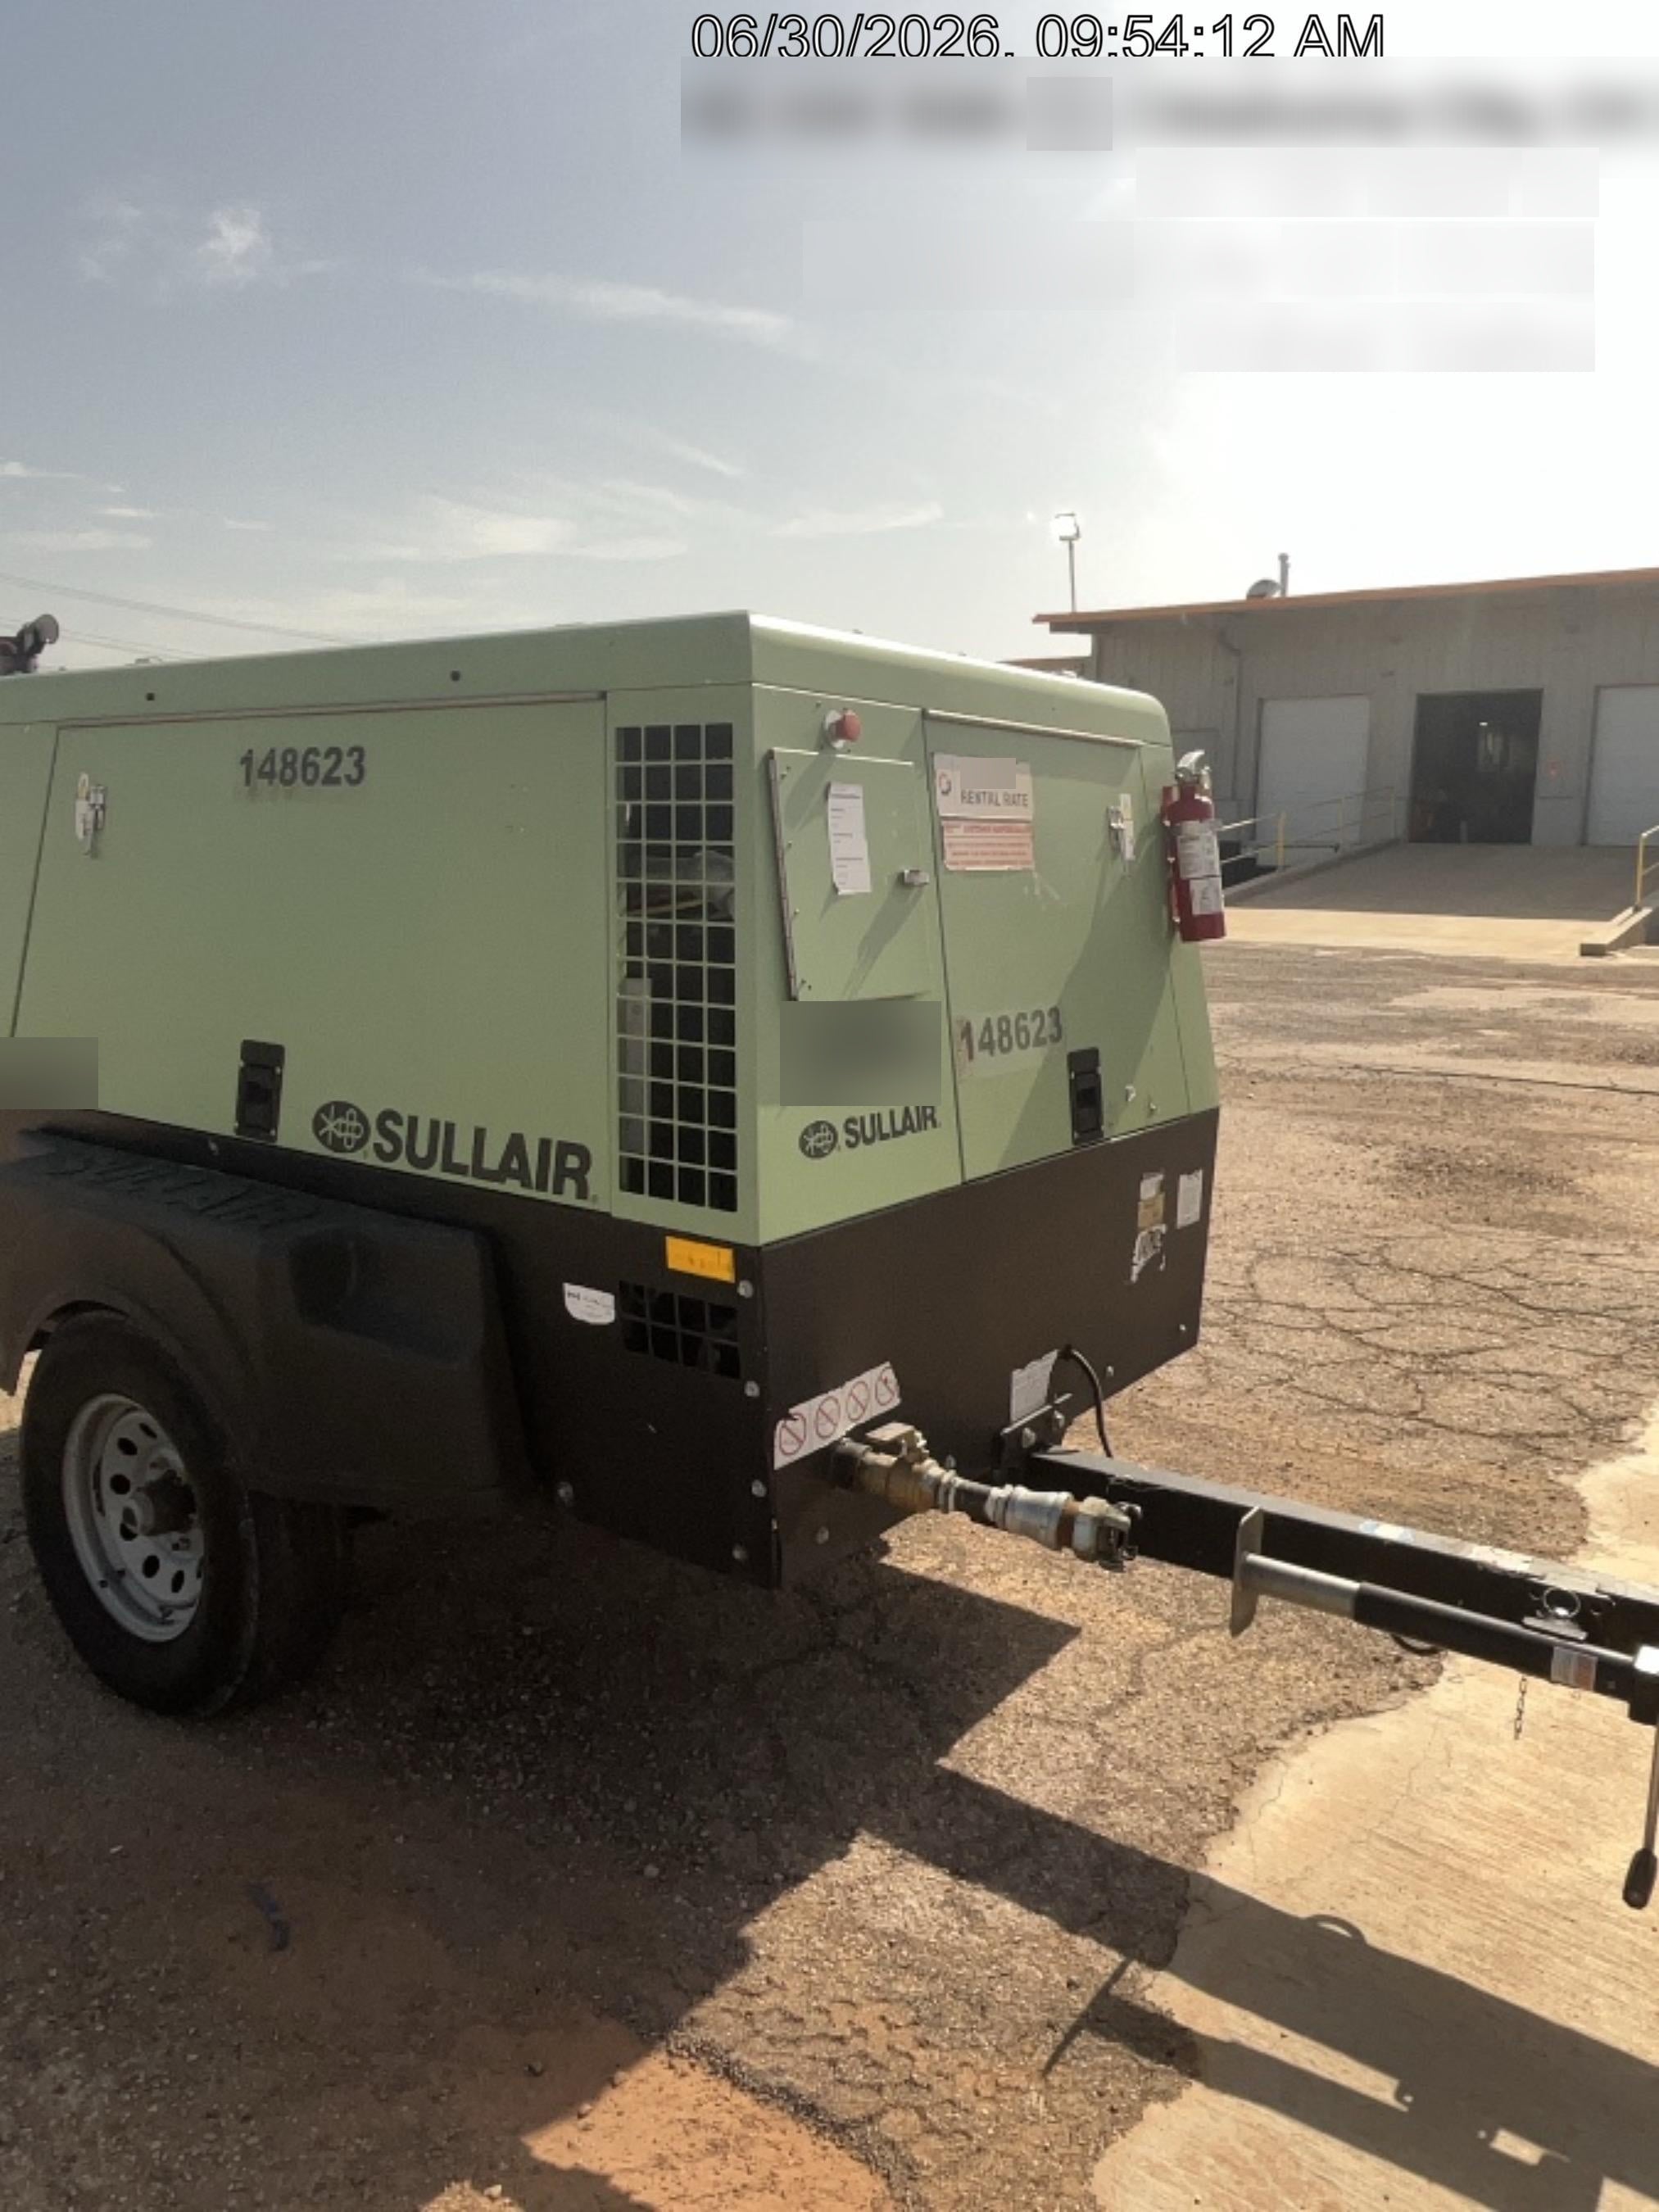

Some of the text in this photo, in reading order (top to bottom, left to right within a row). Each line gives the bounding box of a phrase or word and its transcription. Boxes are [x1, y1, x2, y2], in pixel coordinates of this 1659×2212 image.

[240, 746, 366, 787] 148623
[960, 789, 1029, 808] RENTAL RATE
[960, 1006, 1063, 1063] 148623
[843, 1105, 938, 1149] SULLAIR
[373, 1108, 592, 1200] SULLAIR
